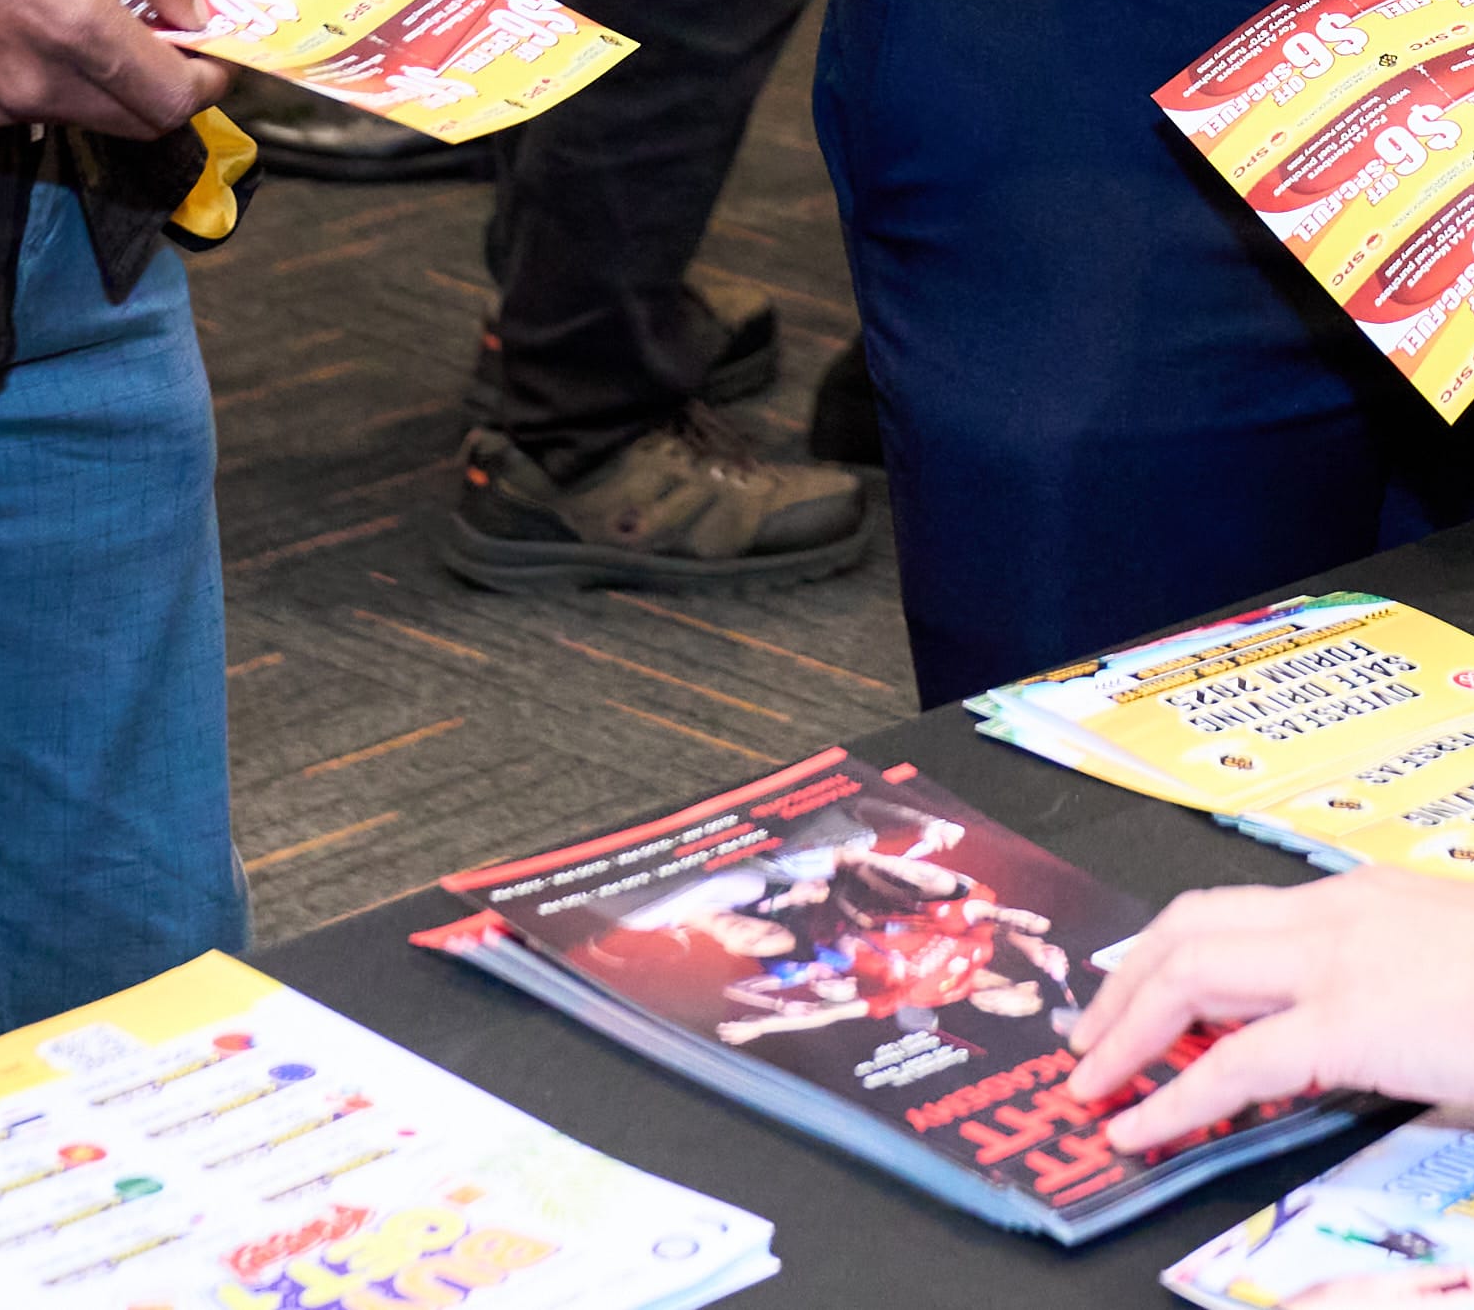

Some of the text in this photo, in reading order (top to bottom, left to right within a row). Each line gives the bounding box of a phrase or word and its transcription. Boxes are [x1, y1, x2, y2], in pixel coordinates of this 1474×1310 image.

[343, 0, 372, 22] SPC
[1268, 10, 1296, 32] every
[1270, 3, 1291, 19] Valid
[482, 28, 520, 58] SPC
[511, 41, 544, 63] OFF
[1213, 33, 1247, 60] February
[1216, 20, 1297, 83] For AA Members
[1226, 46, 1247, 65] fuel
[1283, 13, 1367, 87] $6
[1409, 33, 1449, 51] SPC
[1182, 59, 1228, 98] purchase
[1246, 62, 1291, 100] SPC
[1271, 75, 1306, 106] OFF
[1358, 102, 1387, 126] every
[1360, 95, 1381, 112] Valid
[1386, 88, 1411, 106] with
[1196, 94, 1250, 137] FUEL
[1303, 128, 1337, 157] February
[1307, 113, 1388, 180] For AA Members
[1317, 141, 1339, 162] fuel
[1374, 104, 1460, 179] $6
[1233, 149, 1269, 178] SPC
[1273, 156, 1319, 197] purchase
[1336, 159, 1385, 200] SPC
[1366, 172, 1399, 205] OFF
[1290, 194, 1342, 241] FUEL
[1400, 229, 1433, 261] February
[1448, 228, 1466, 246] AA
[1332, 251, 1365, 286] SPC
[1406, 242, 1452, 288] Members
[1414, 244, 1436, 266] fuel
[1374, 260, 1416, 307] purchase
[1396, 304, 1444, 354] FUEL
[1440, 369, 1473, 404] SPC
[1255, 641, 1377, 683] FORUM
[1328, 655, 1417, 689] SAFE
[1165, 676, 1262, 710] 2025
[1189, 683, 1332, 732] DRIVING
[1255, 683, 1421, 740] OVERSEAS
[905, 1047, 1077, 1133] ACADEMY
